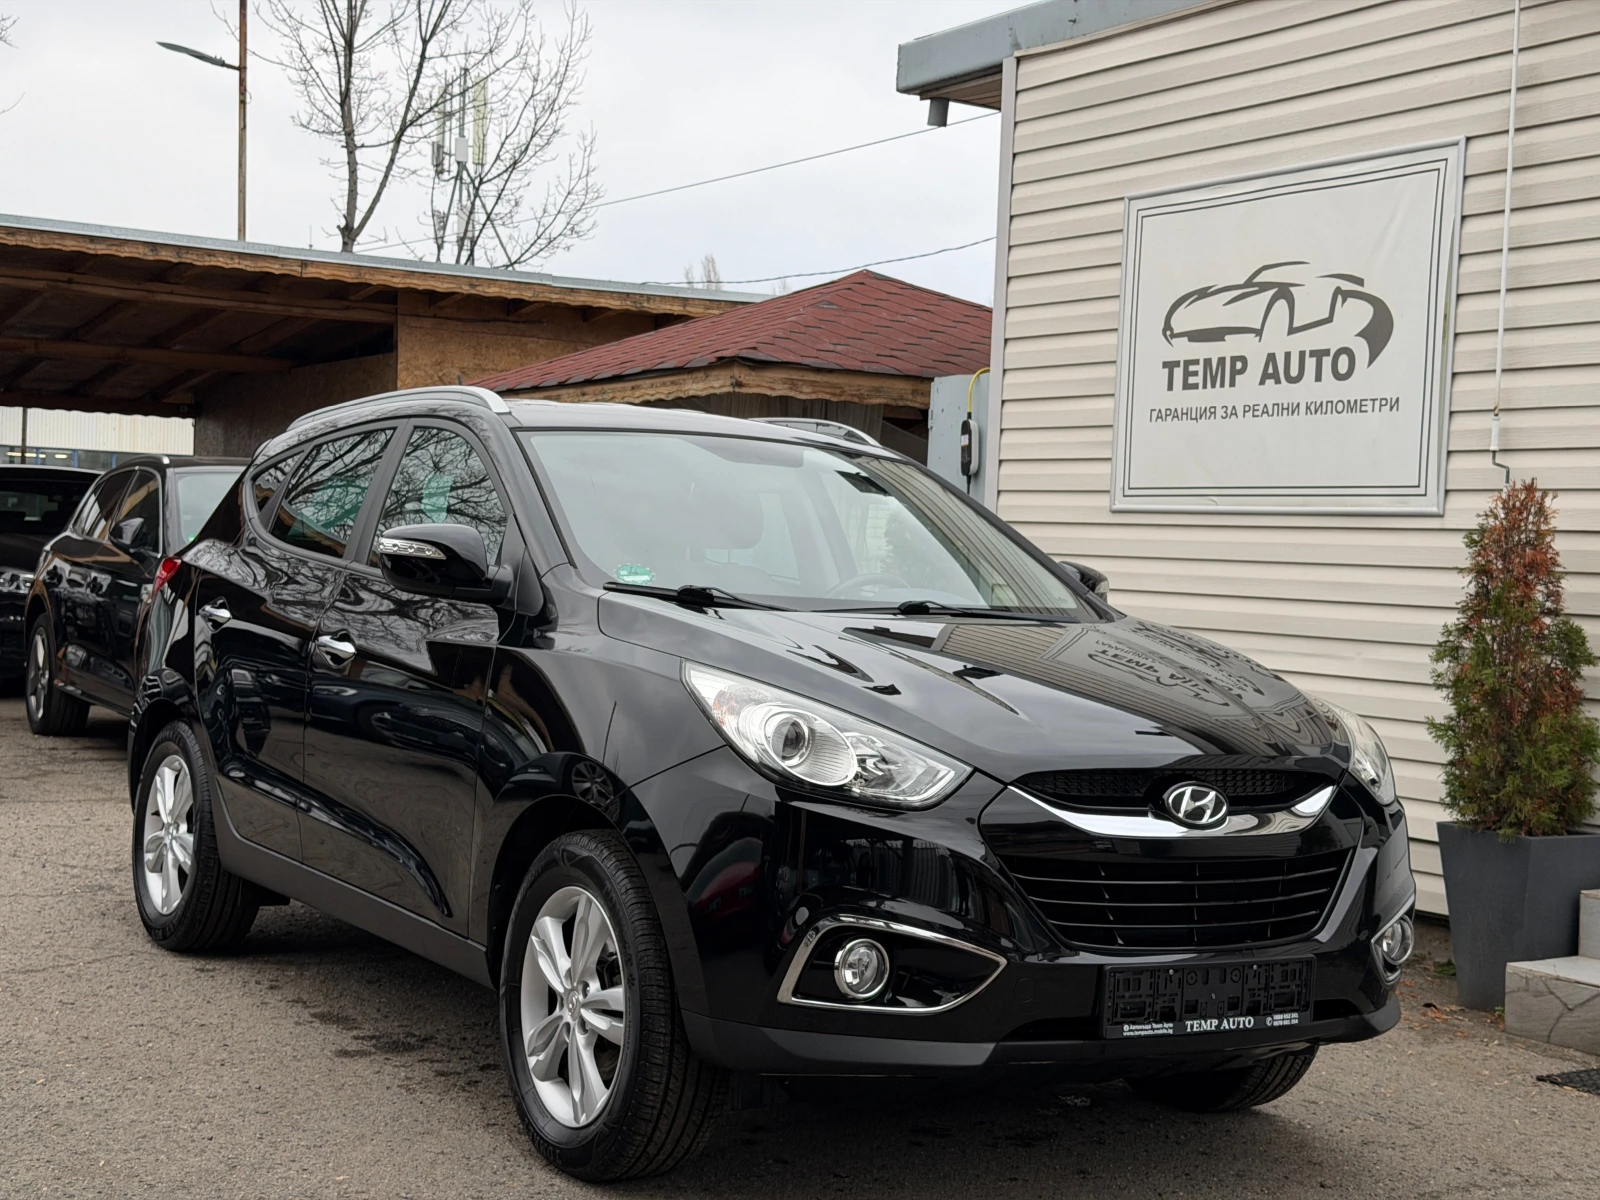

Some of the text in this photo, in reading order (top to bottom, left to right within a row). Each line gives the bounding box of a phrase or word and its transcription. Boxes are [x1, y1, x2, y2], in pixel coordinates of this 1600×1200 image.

[1162, 346, 1356, 391] TEMP AUTO
[1149, 397, 1400, 423] ГАРАНЦИЯ ЗА РЕАЛНИ КИЛОМЕТРИ
[1185, 1016, 1254, 1032] TEMP AUTO
